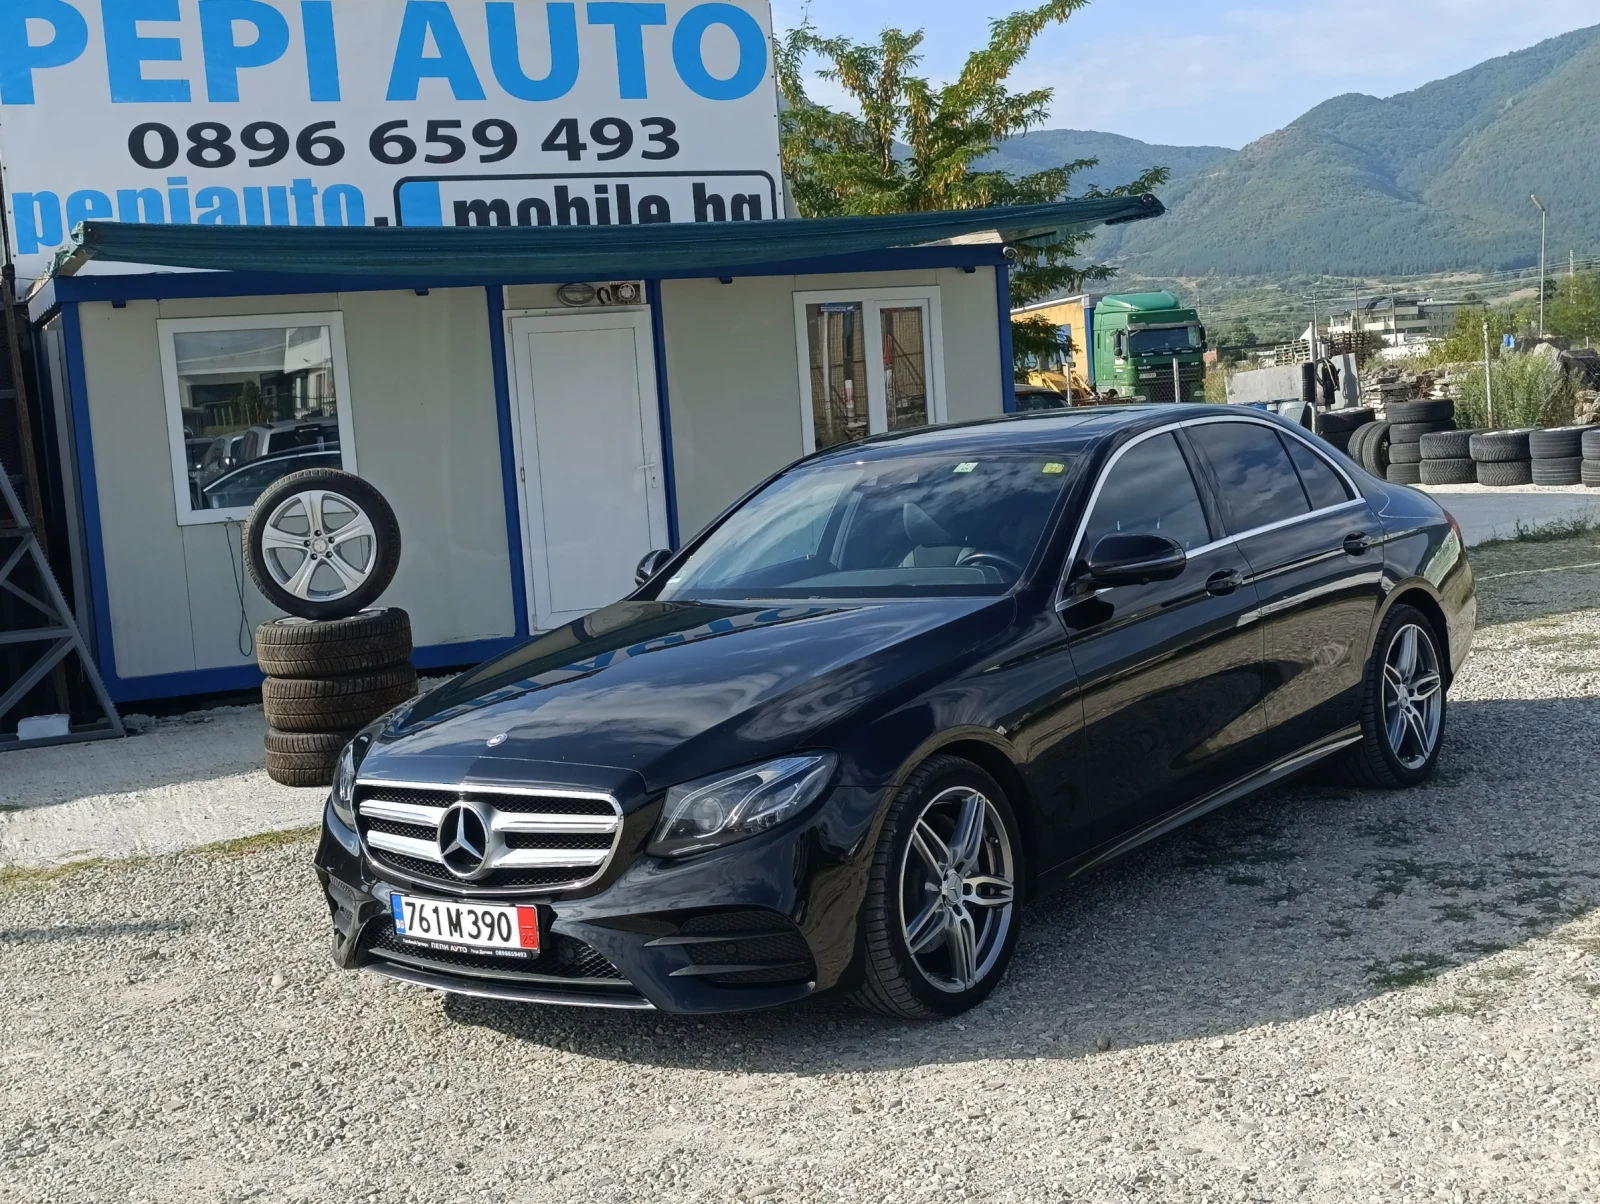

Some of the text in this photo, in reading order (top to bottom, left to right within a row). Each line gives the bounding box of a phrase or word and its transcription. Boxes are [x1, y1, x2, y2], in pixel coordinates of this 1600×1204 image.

[0, 0, 768, 105] PEPI AUTO
[127, 116, 681, 170] 0896 659 493
